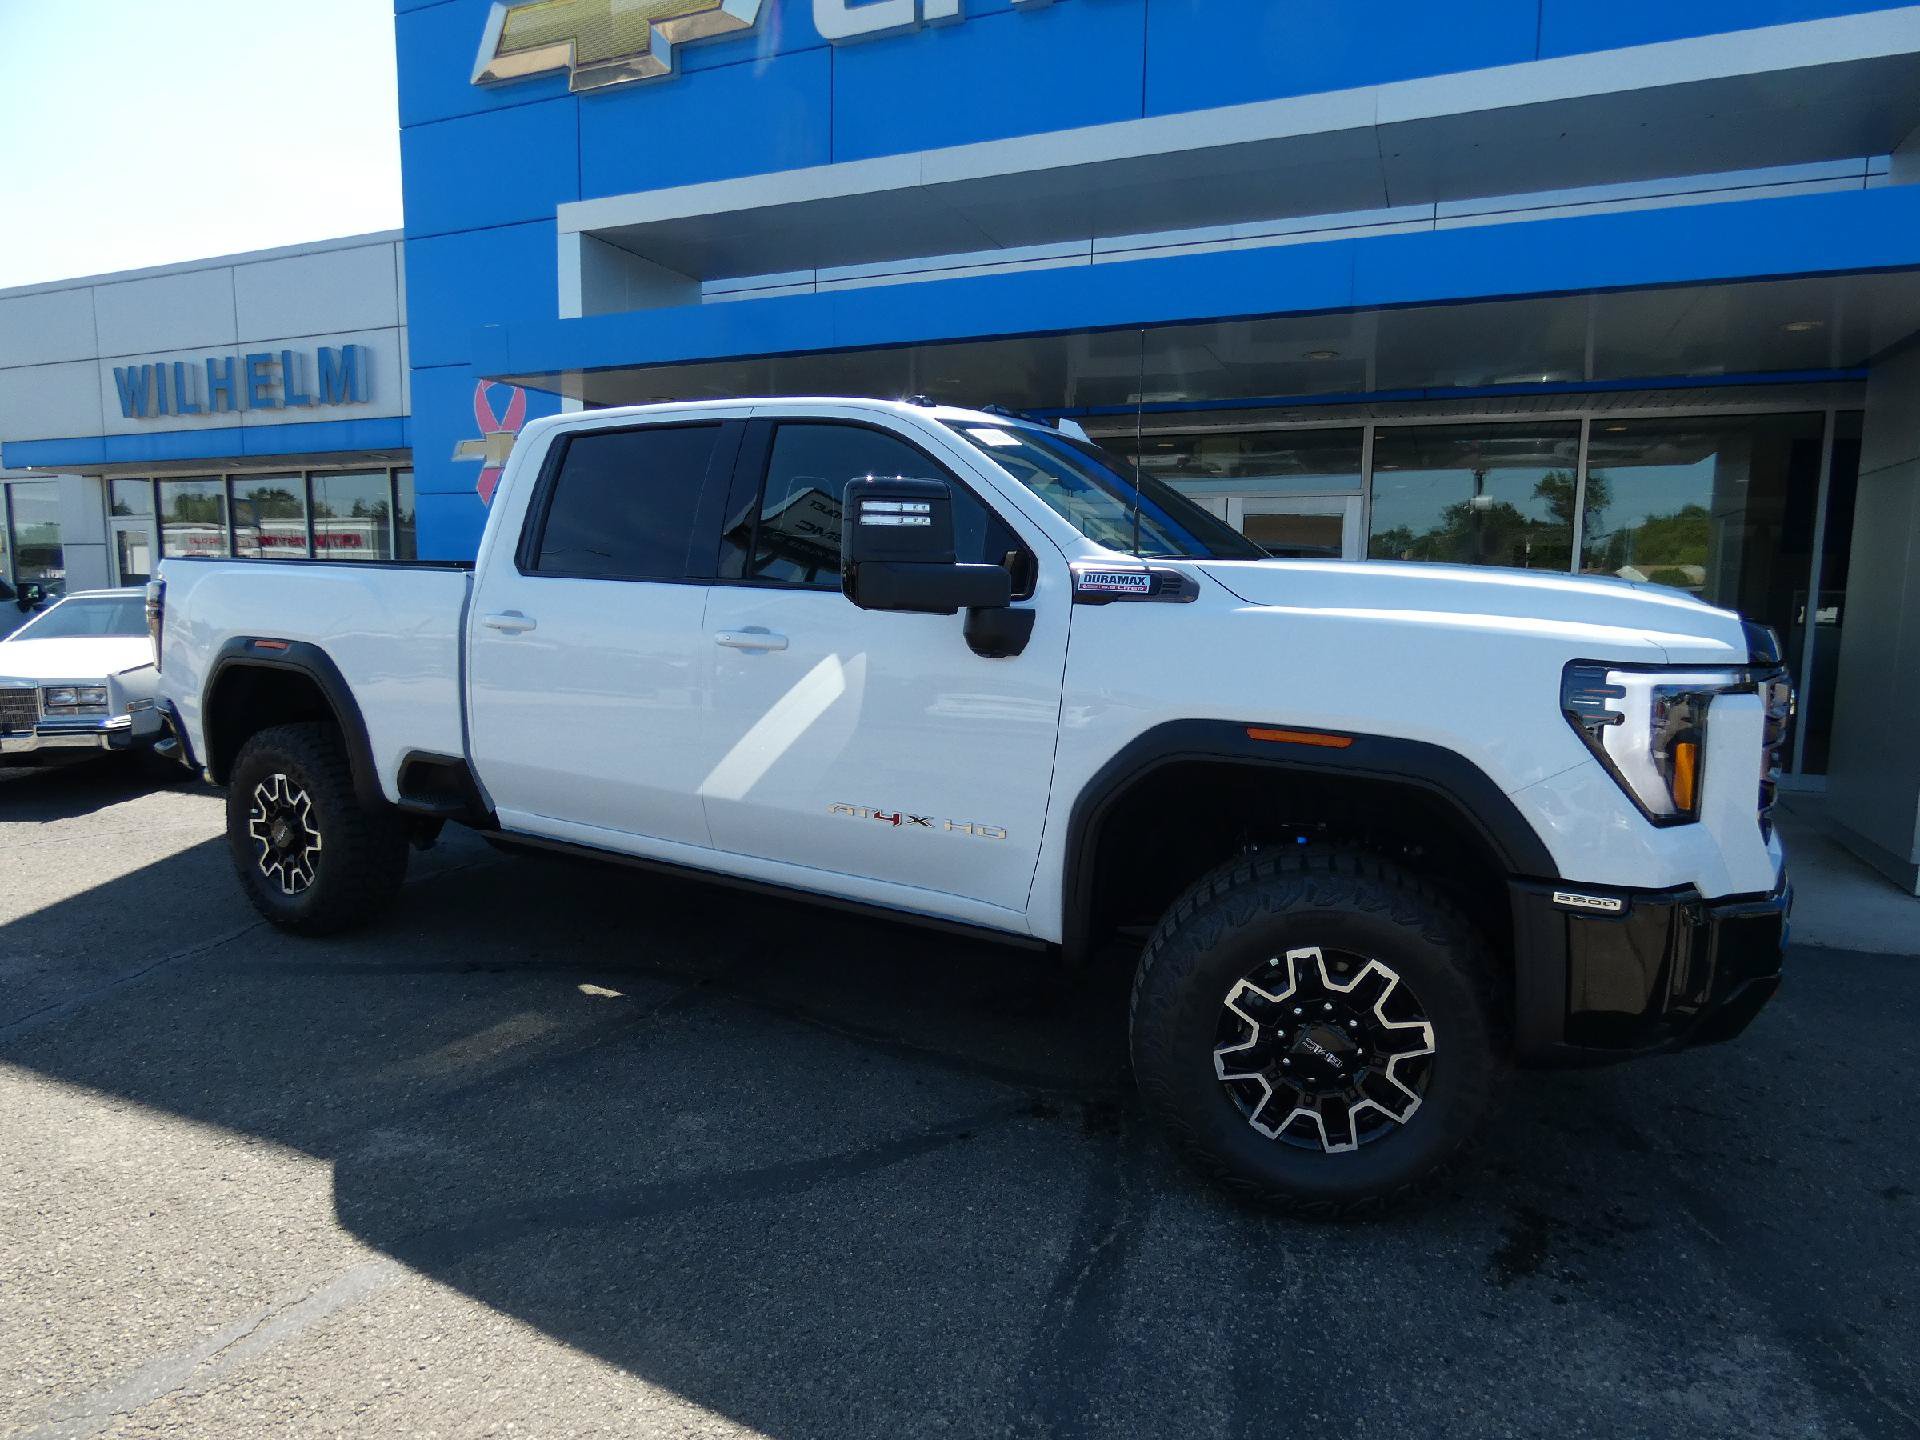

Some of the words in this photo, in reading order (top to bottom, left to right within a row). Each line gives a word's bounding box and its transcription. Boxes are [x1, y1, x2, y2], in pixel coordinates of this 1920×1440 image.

[114, 344, 367, 418] WILHELM
[1083, 574, 1147, 586] DURAMAX
[827, 801, 935, 827] AT4X
[944, 818, 1007, 840] HD
